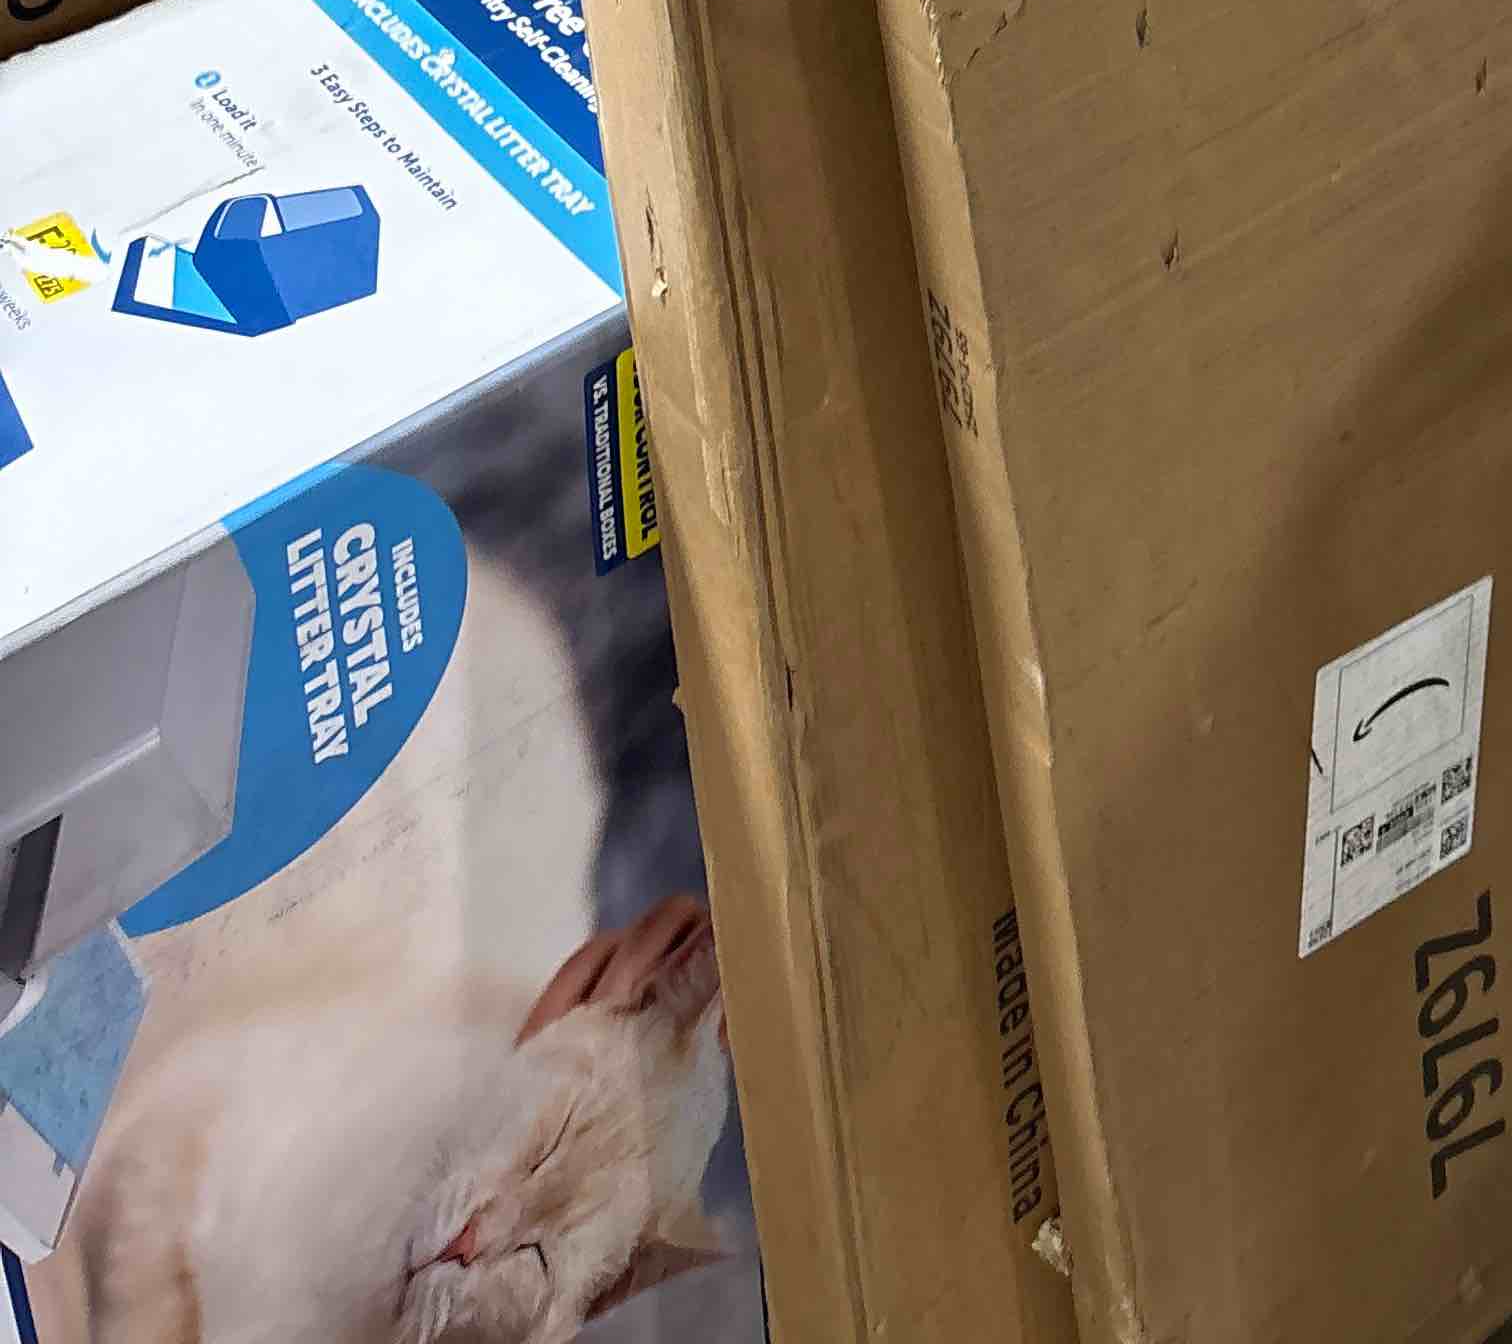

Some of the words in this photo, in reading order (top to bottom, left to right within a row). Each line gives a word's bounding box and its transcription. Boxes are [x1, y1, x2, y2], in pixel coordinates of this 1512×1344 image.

[310, 63, 330, 77] 3
[319, 72, 354, 105] Easy
[211, 88, 245, 121] Load
[241, 114, 257, 132] it
[347, 100, 388, 139] Steps
[419, 49, 495, 126] CRYSTAL
[482, 115, 551, 180] LITTER
[540, 167, 596, 216] TRAY
[220, 129, 260, 168] minute
[381, 132, 402, 154] to
[396, 151, 459, 212] Maintain
[592, 375, 609, 404] VS.
[594, 402, 614, 510] TRADITIONAL
[599, 507, 618, 561] BOXES
[287, 527, 335, 673] LITTER
[391, 535, 424, 654] INCLUDES
[333, 522, 393, 729] CRYSTAL
[304, 658, 350, 765] TRAY
